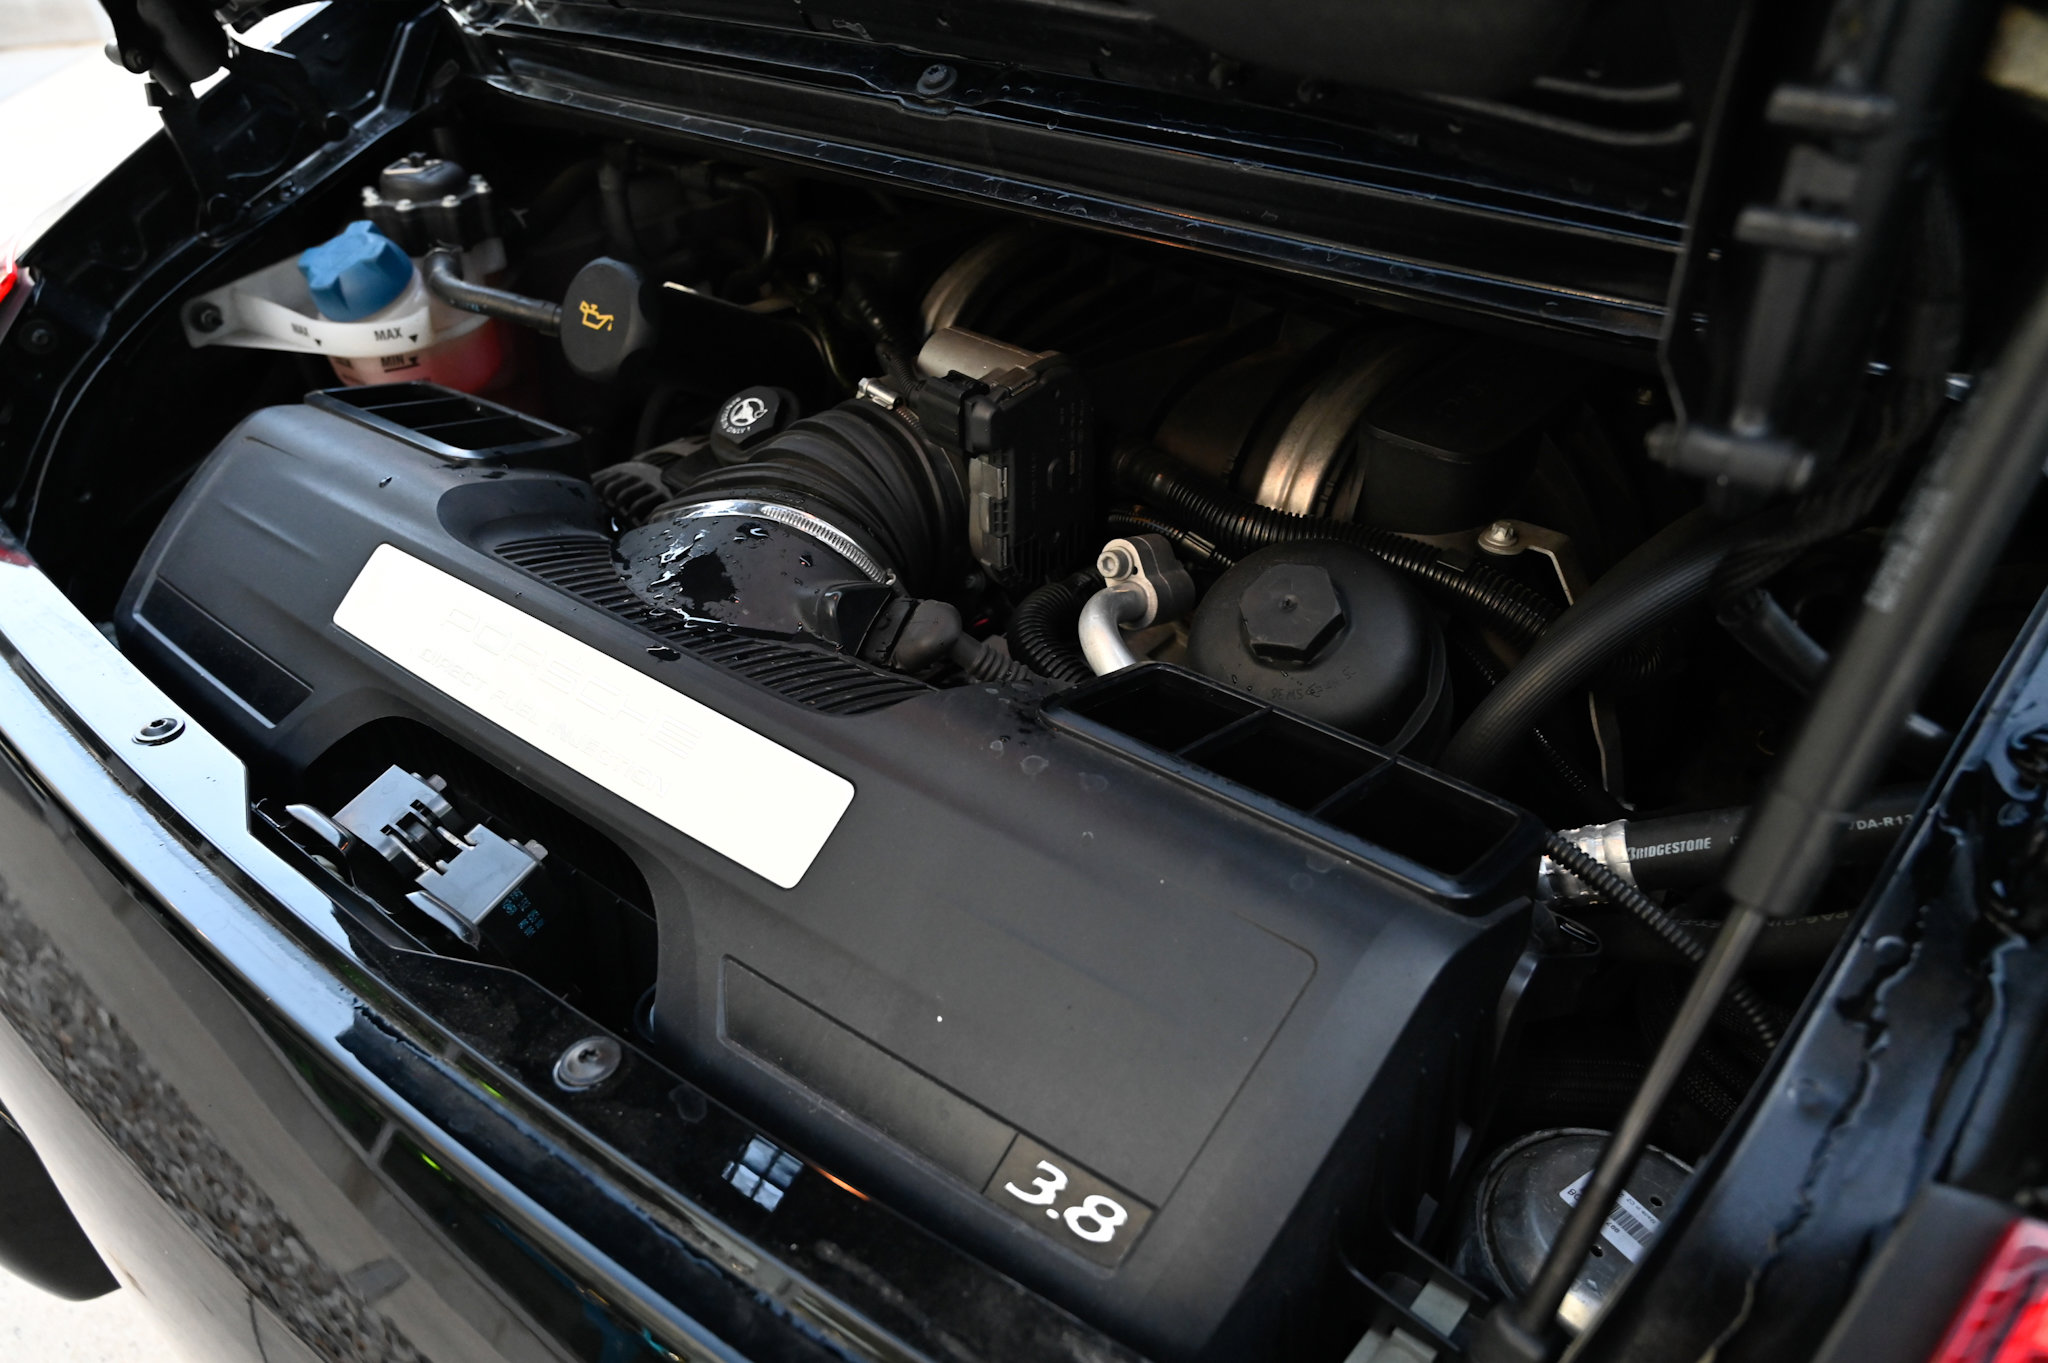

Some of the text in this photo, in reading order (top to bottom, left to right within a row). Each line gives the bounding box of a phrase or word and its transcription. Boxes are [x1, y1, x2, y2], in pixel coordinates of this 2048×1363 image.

[374, 327, 404, 341] MAX
[380, 355, 405, 367] MIN
[440, 608, 702, 760] PORSCHE
[417, 647, 673, 799] DIRECT FUEL INJECTION
[1627, 836, 1712, 861] BRIDGESTONE
[1003, 1159, 1129, 1243] 3.8
